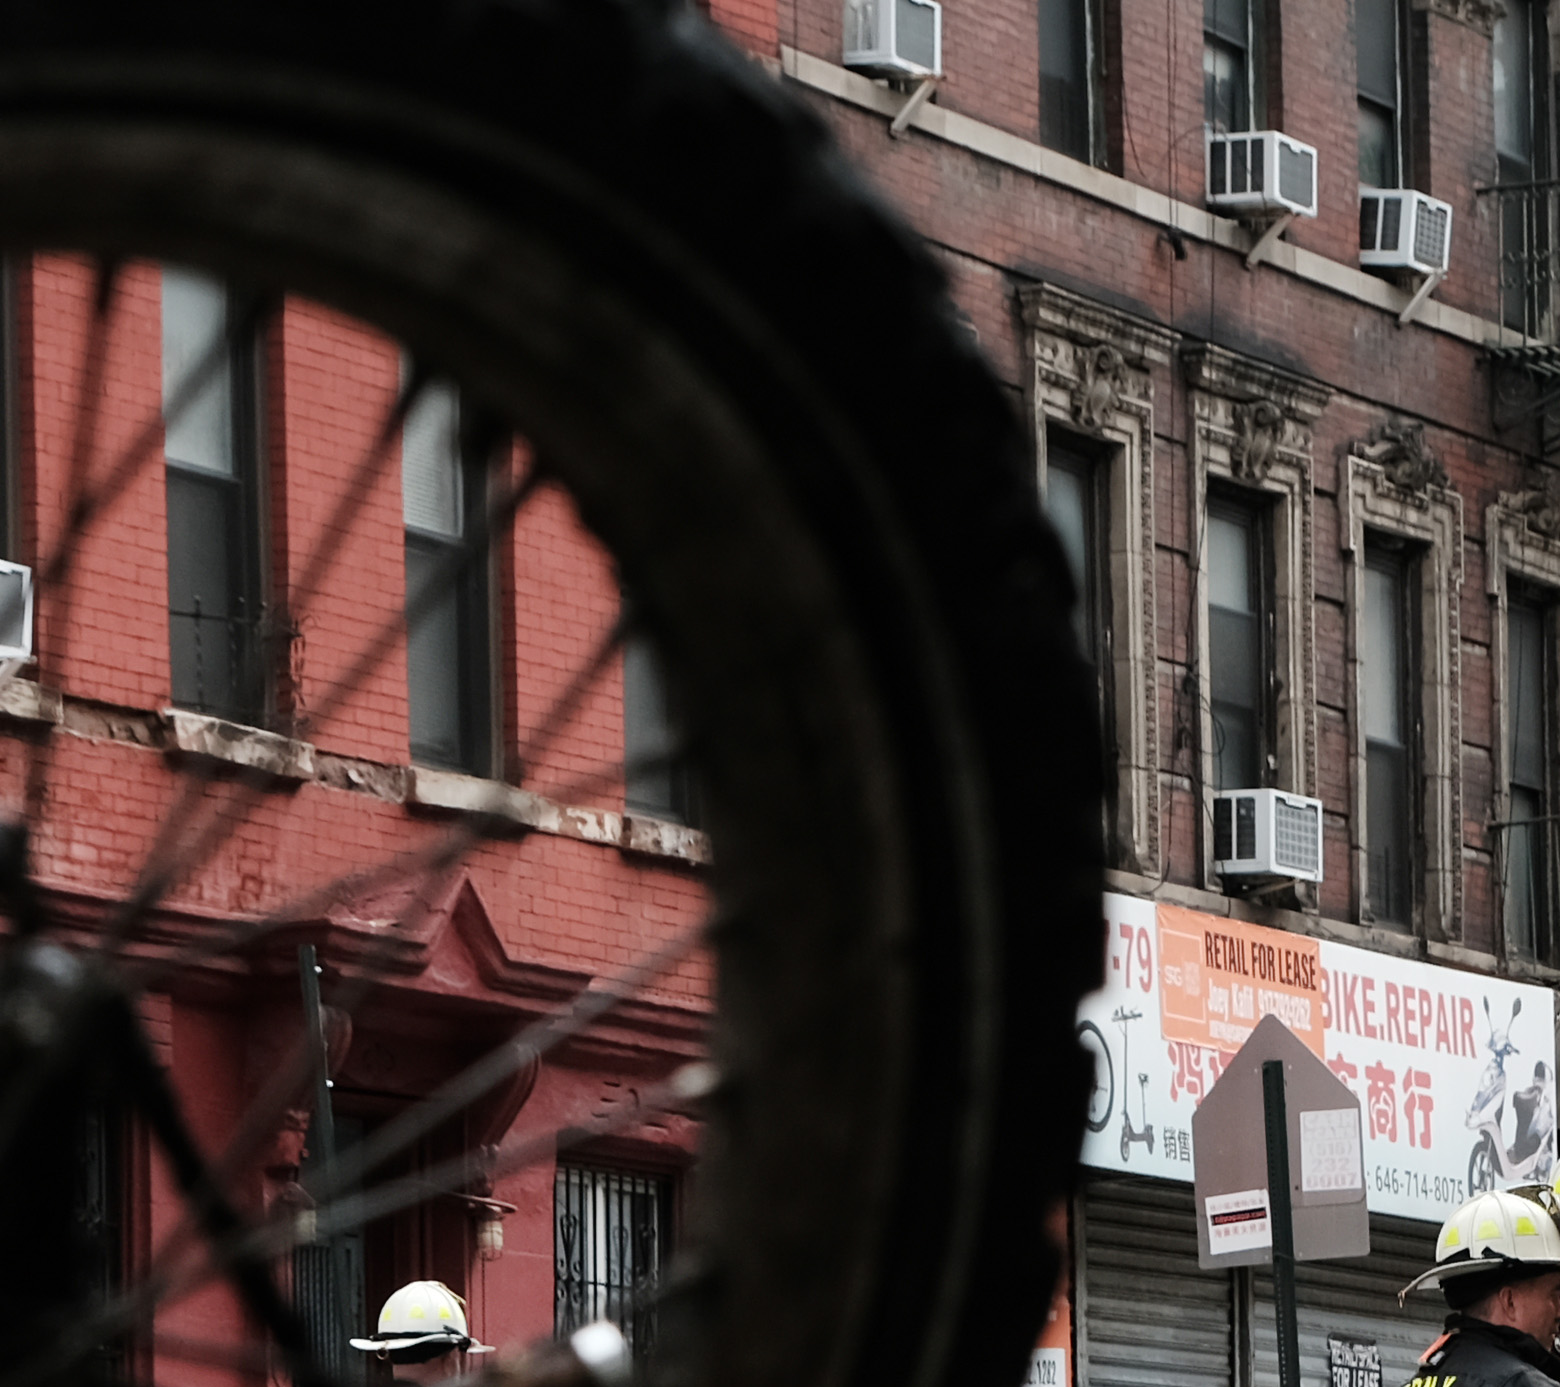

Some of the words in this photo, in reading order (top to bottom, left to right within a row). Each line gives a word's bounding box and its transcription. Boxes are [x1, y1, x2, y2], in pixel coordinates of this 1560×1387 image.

[1204, 930, 1249, 976] RETAIL
[1250, 942, 1276, 983] FOR
[1278, 949, 1317, 991] LEASE
[1375, 1164, 1464, 1205] 646-714-8075
